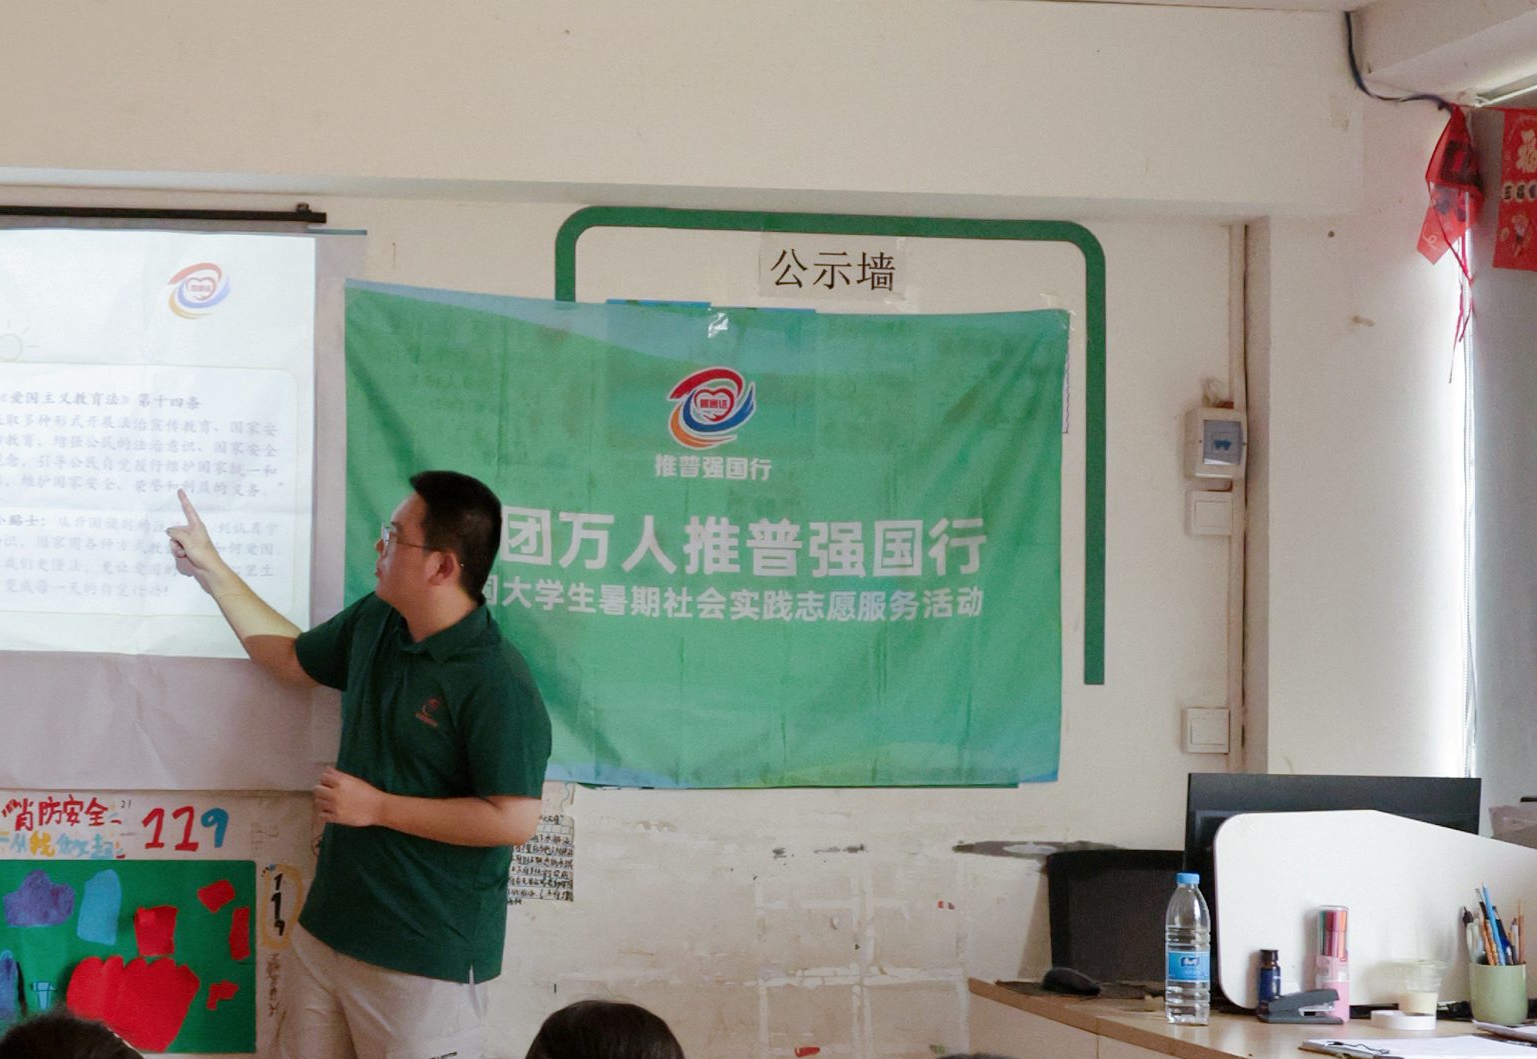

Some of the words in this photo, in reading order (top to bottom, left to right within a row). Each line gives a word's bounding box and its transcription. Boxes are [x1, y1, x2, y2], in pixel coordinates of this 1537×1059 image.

[770, 248, 896, 291] 公示墙
[0, 391, 202, 410] 《爱国主义教育法》第十四条
[655, 453, 772, 480] 推普强国行
[500, 505, 987, 578] 团万人推普强国行
[142, 806, 229, 851] 119
